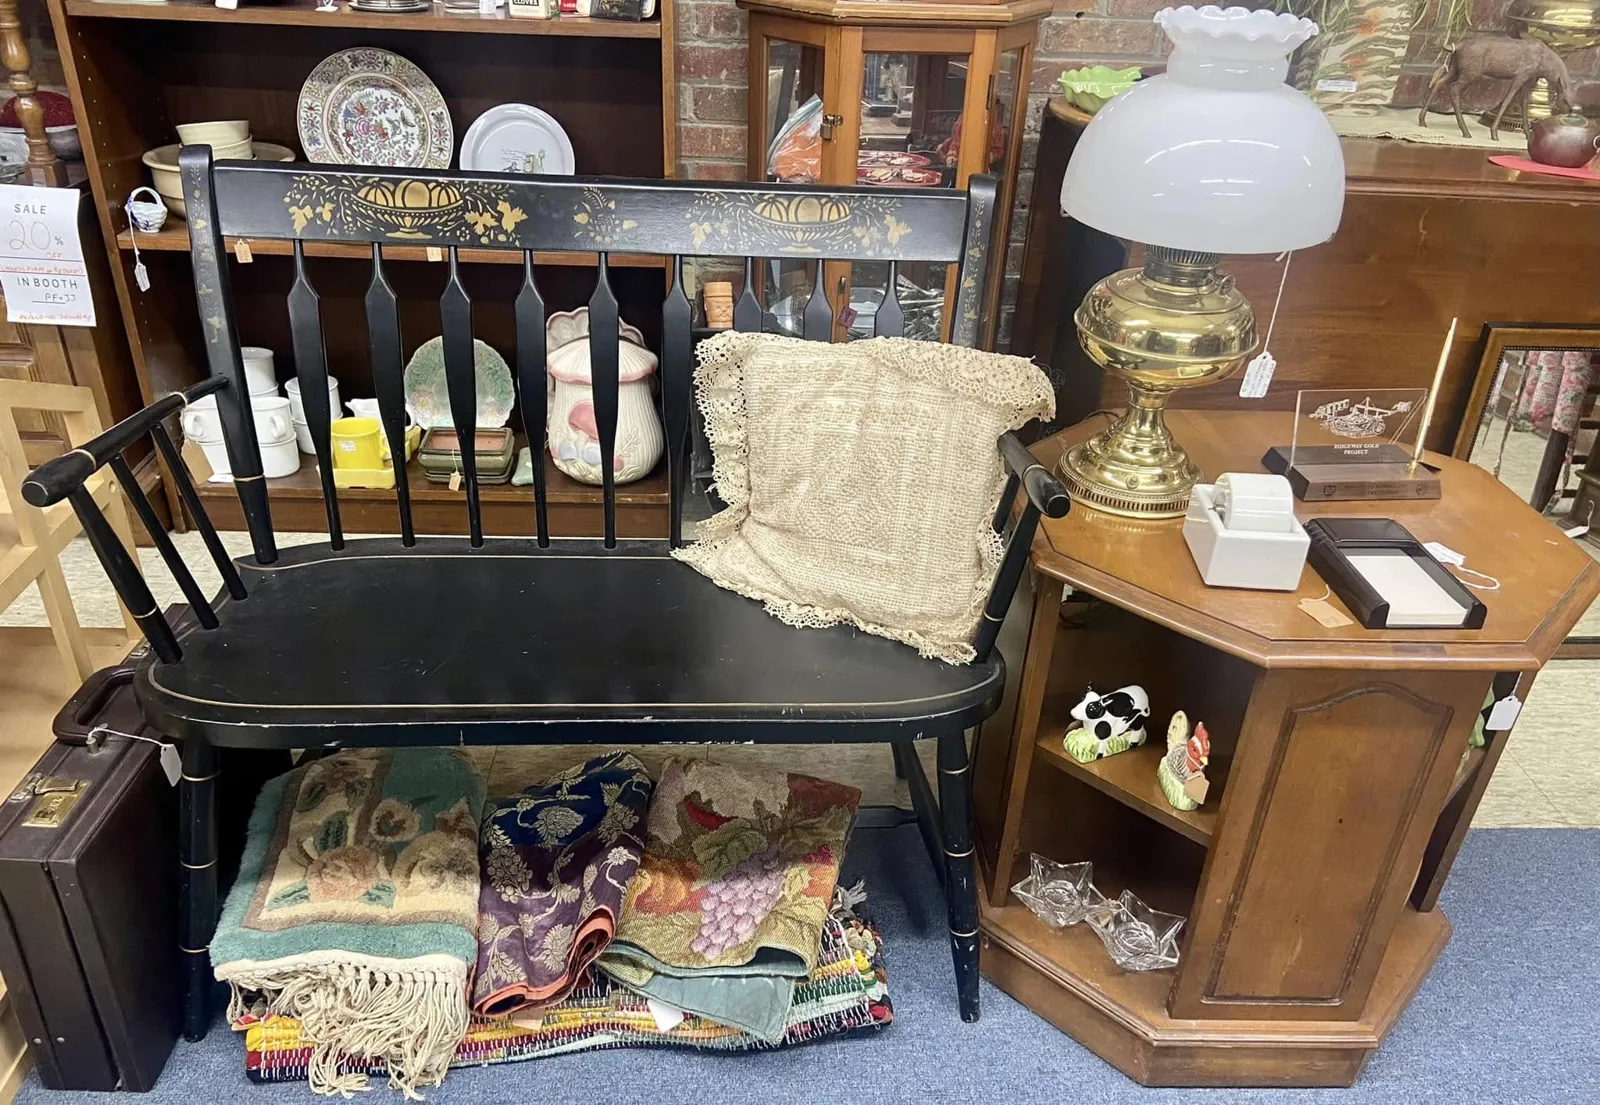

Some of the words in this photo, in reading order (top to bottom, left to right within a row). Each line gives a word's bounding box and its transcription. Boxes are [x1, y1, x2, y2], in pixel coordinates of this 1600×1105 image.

[14, 203, 47, 214] SALE
[17, 277, 30, 286] IN
[33, 278, 78, 289] BOOTH
